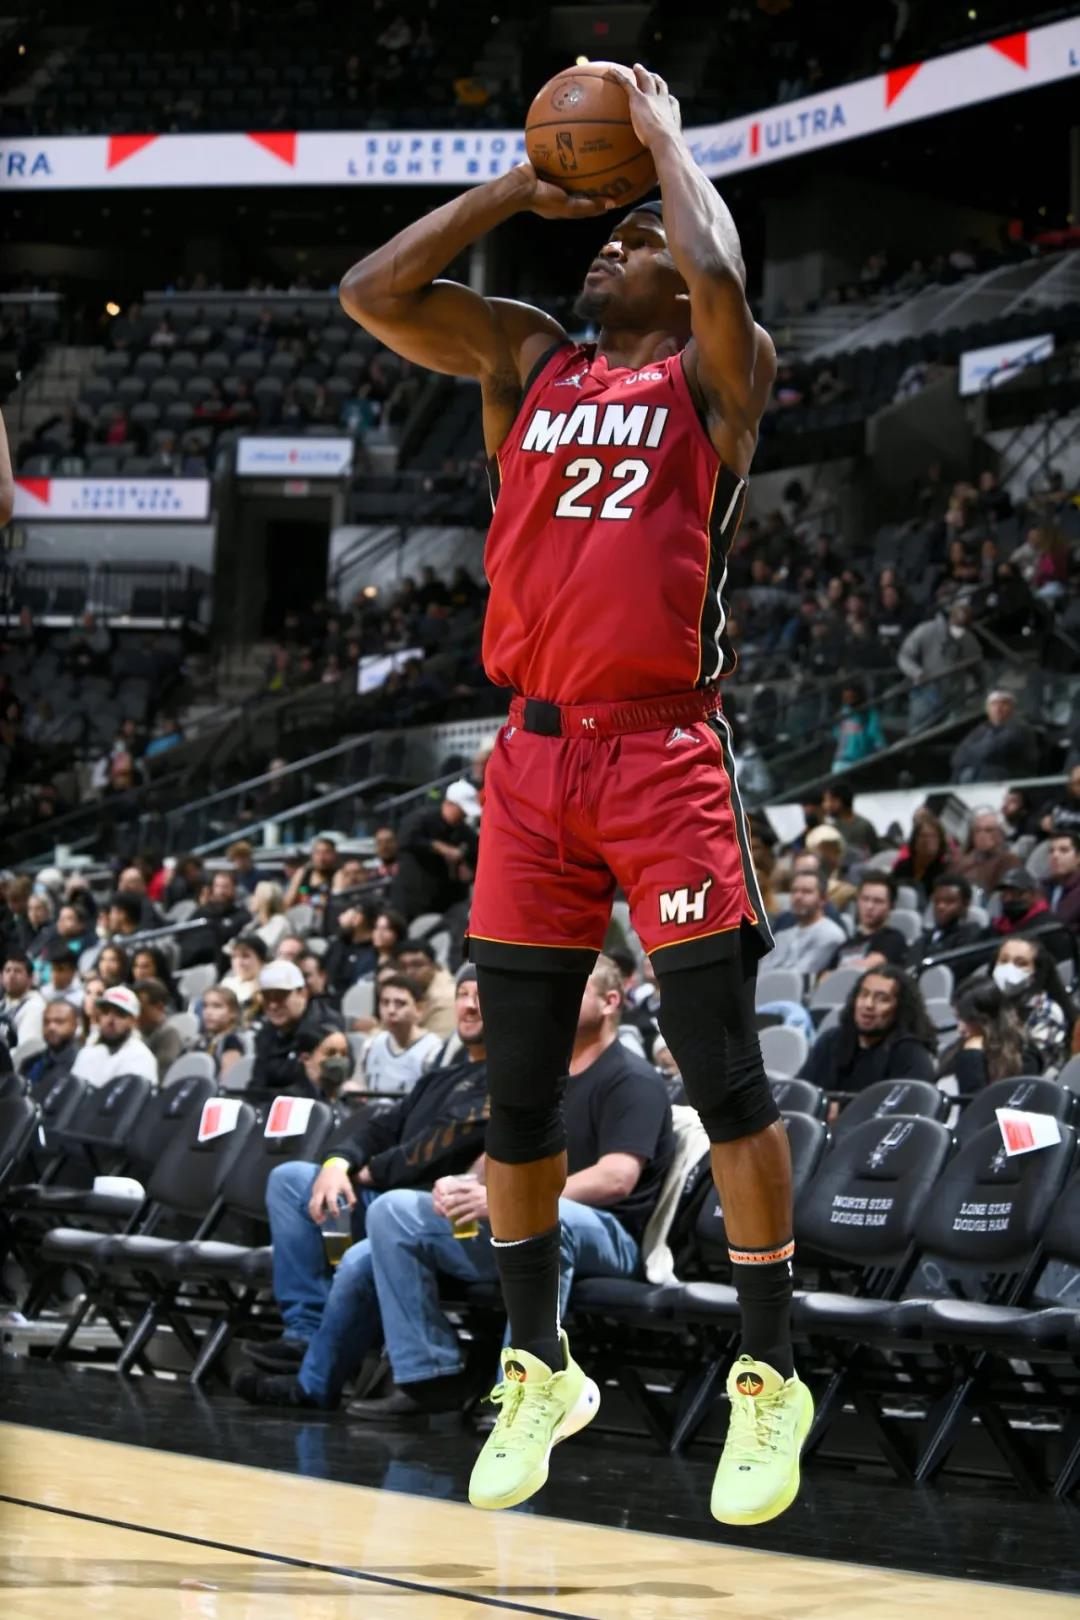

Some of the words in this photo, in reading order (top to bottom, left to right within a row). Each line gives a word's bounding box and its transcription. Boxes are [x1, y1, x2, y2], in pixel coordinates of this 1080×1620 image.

[765, 103, 847, 149] ULTRA
[0, 152, 52, 177] RA
[348, 159, 441, 176] LIGHT
[554, 456, 650, 520] 22
[832, 1195, 869, 1210] NORTH
[868, 1198, 893, 1211] STAR
[960, 1202, 987, 1216] LONE
[987, 1202, 1012, 1215] STAR
[830, 1210, 864, 1226] DODGE
[864, 1213, 887, 1227] RAM
[953, 1218, 987, 1232] DODGE
[987, 1217, 1009, 1232] RAM
